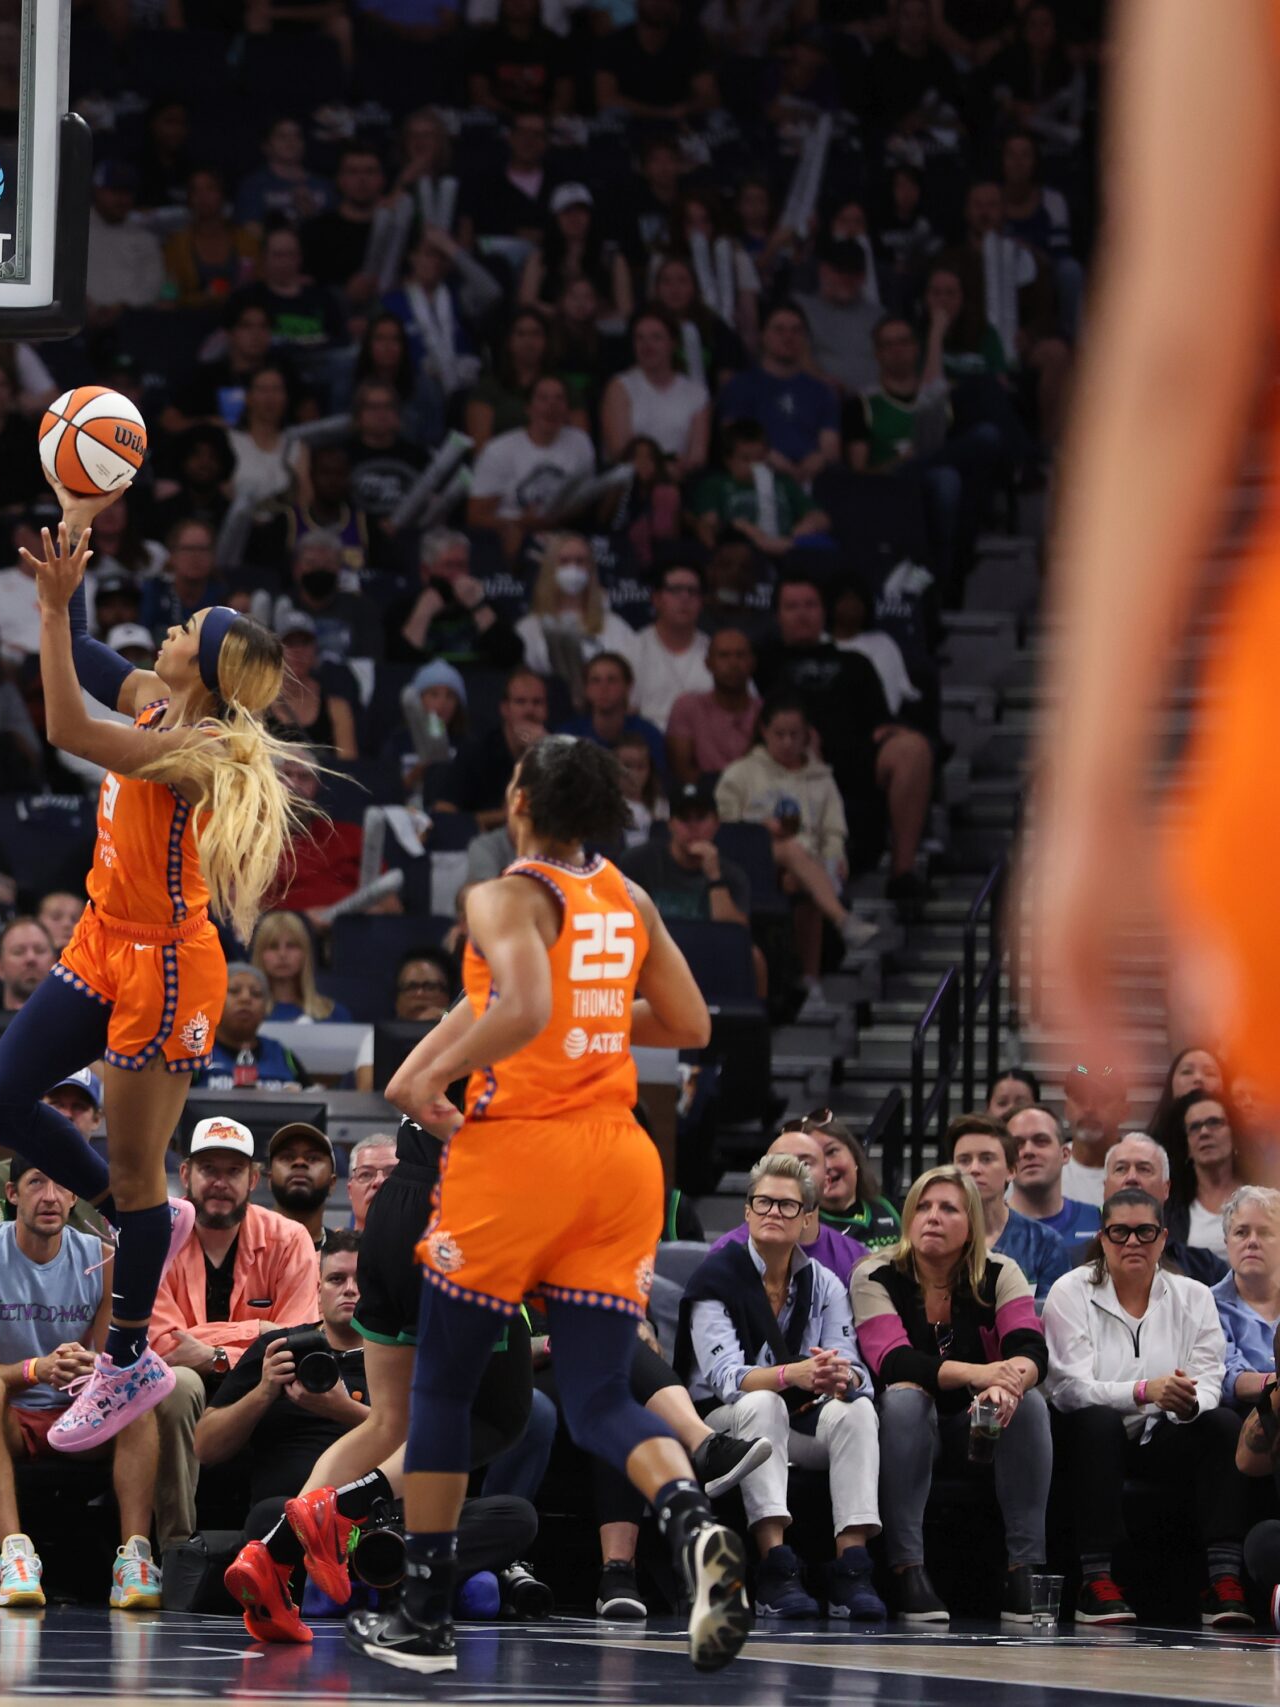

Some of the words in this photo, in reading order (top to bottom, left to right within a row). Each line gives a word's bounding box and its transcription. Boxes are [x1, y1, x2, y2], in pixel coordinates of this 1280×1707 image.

[114, 424, 146, 457] Wils
[569, 911, 635, 981] 25
[573, 989, 624, 1018] THOMAS
[589, 1032, 625, 1054] AT&T
